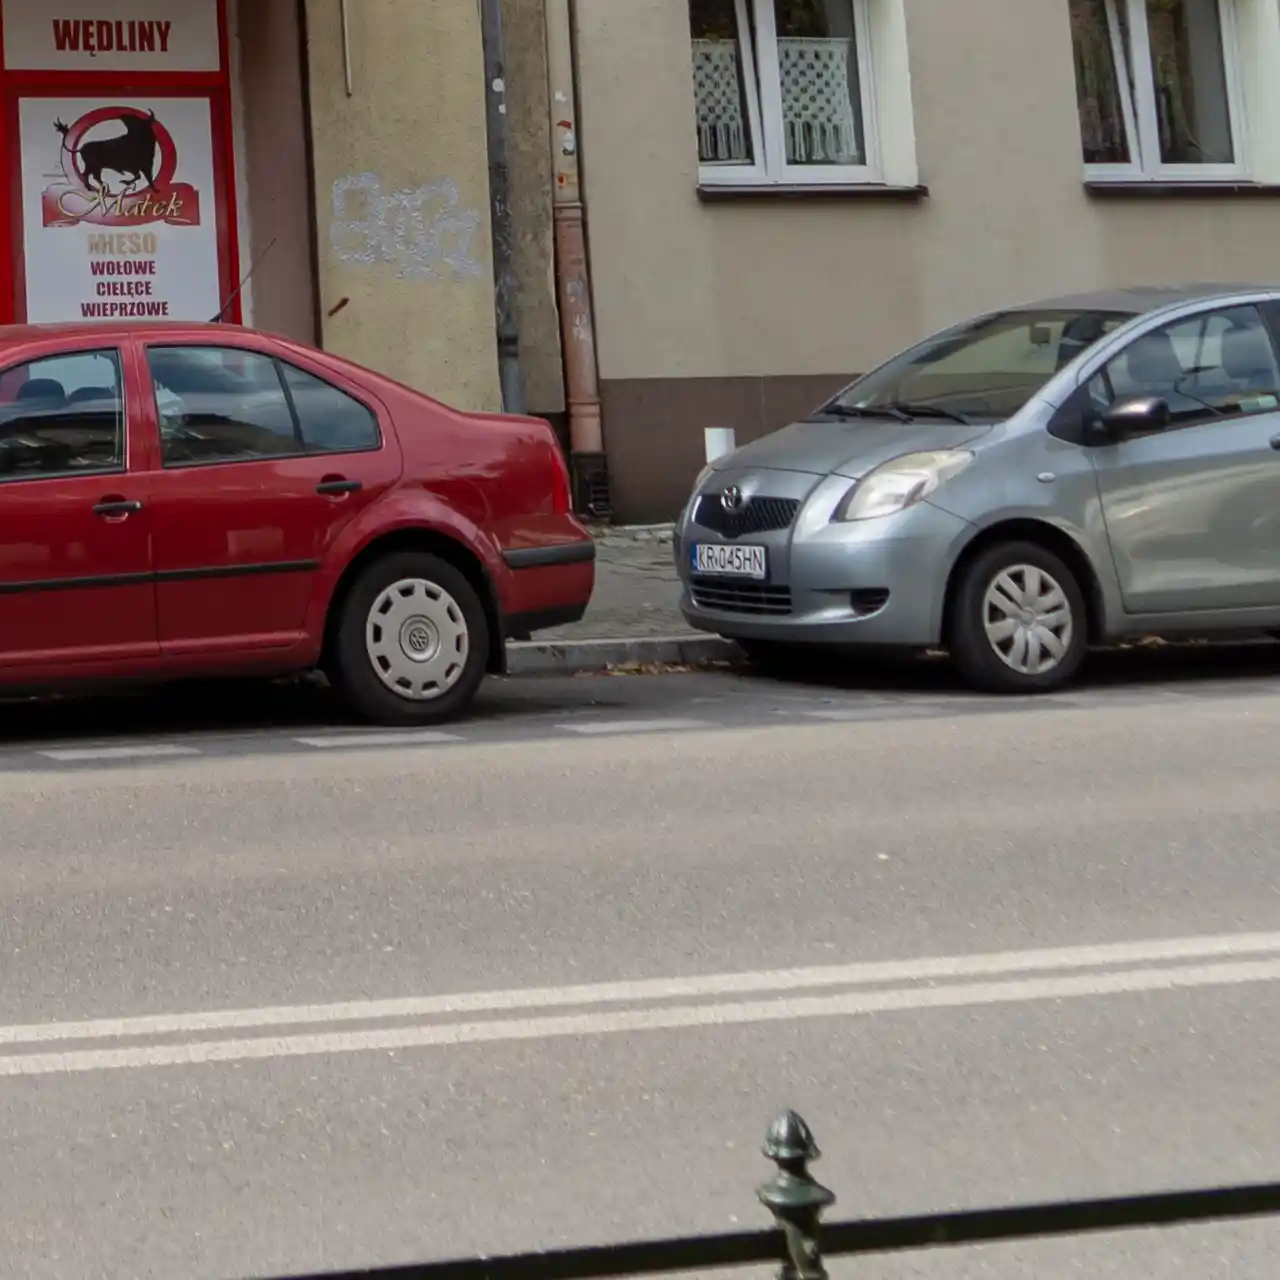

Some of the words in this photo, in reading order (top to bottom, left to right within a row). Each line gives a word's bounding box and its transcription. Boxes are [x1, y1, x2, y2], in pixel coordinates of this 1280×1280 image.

[52, 19, 171, 56] WĘDLINY
[87, 232, 157, 256] MIĘSO
[90, 260, 156, 276] WOŁOWE
[96, 281, 153, 298] CIELĘCE
[81, 301, 169, 317] WIEPRZOWE
[699, 546, 715, 569] KR
[719, 547, 762, 571] 045HN
